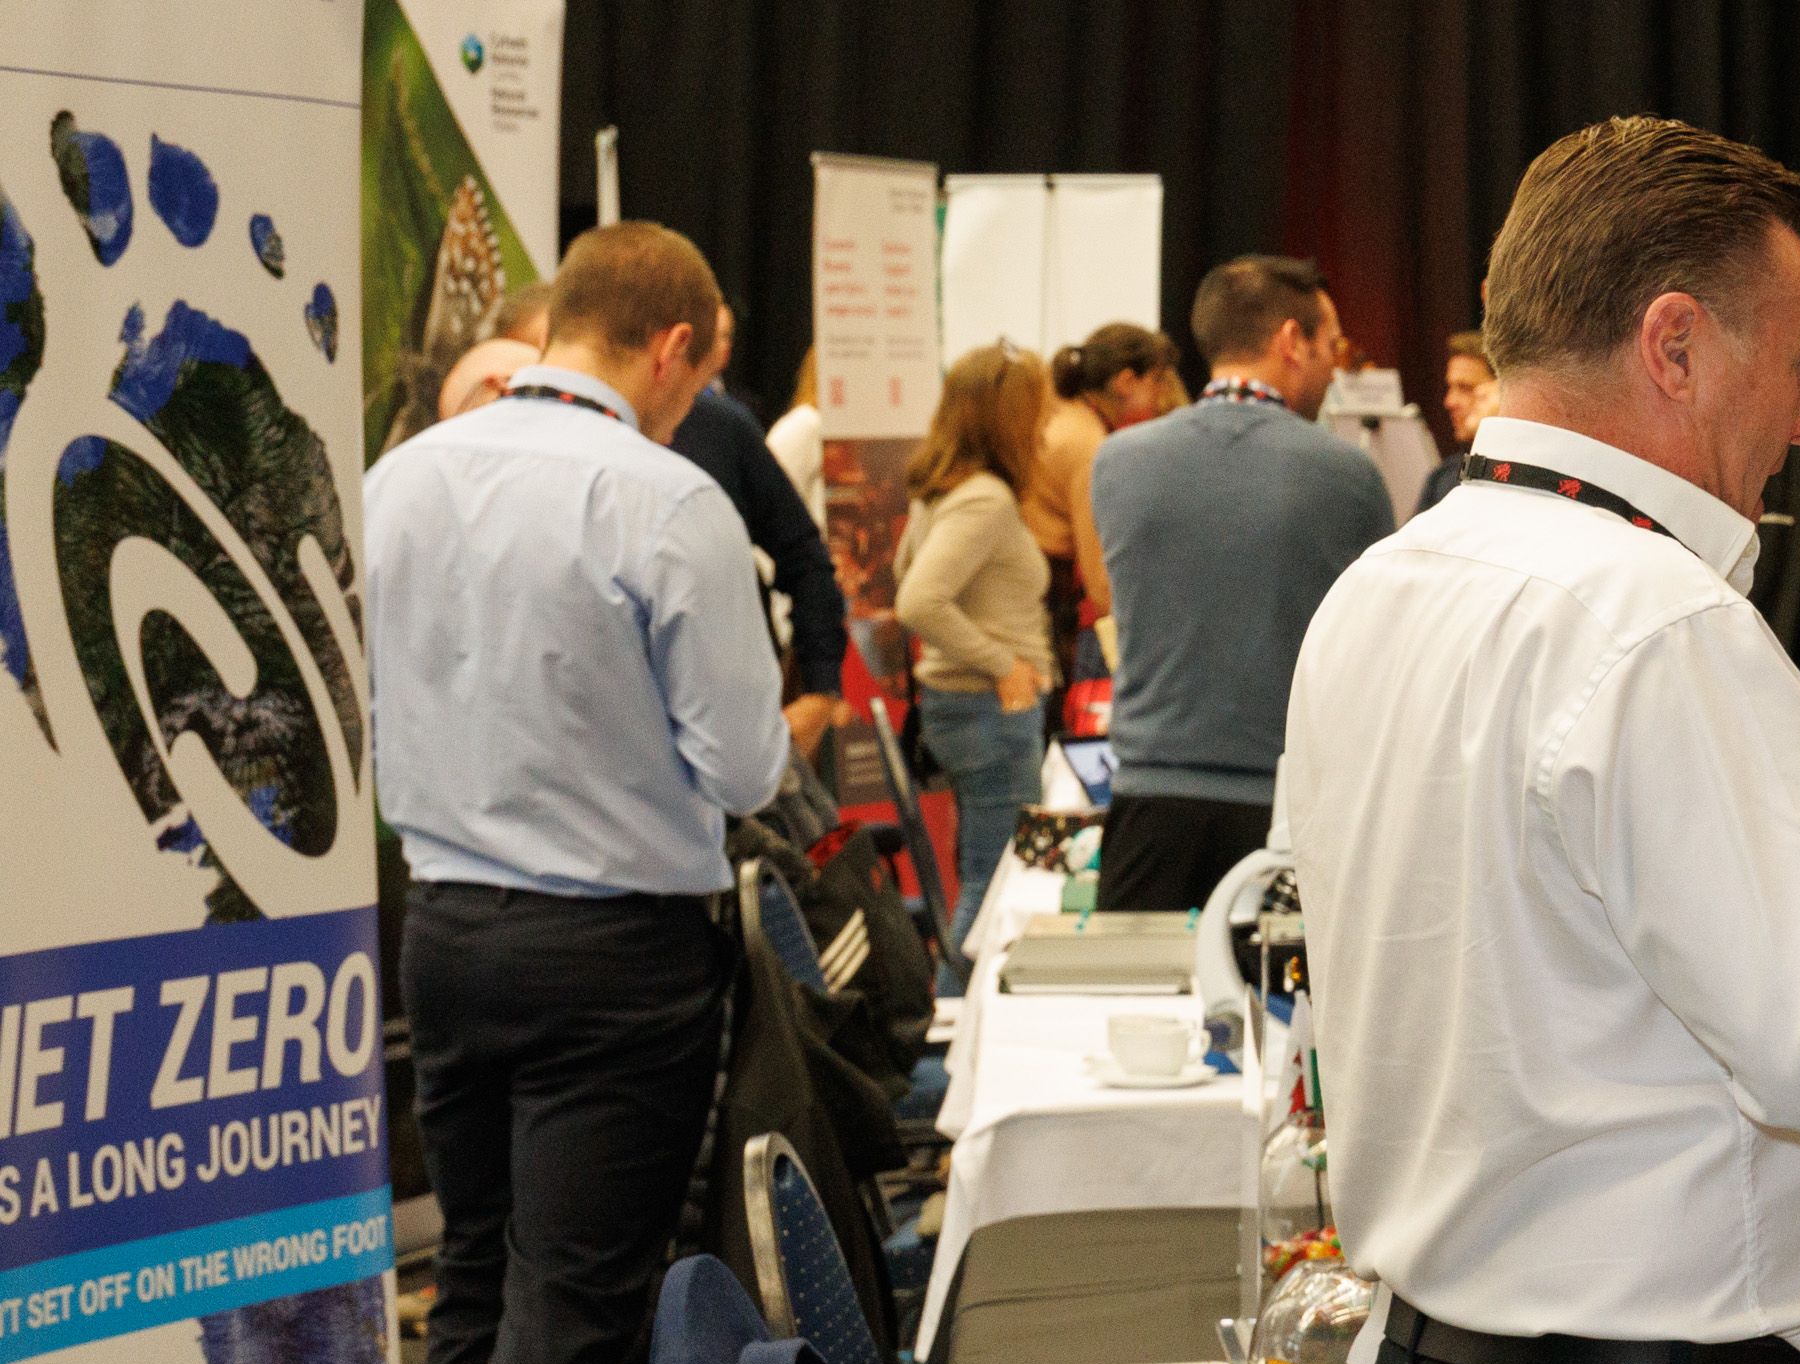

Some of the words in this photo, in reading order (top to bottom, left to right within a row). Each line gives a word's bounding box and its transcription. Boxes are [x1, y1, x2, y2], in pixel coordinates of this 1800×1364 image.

[150, 951, 377, 1110] ZERO
[30, 1158, 58, 1218] A
[68, 1133, 186, 1208] LONG
[197, 1095, 382, 1182] JOURNEY
[26, 1287, 76, 1331] SET
[80, 1270, 132, 1315] OFF
[136, 1264, 175, 1302] ON
[180, 1255, 229, 1294] THE
[233, 1229, 327, 1280] WRONG
[332, 1215, 388, 1259] FOOT
